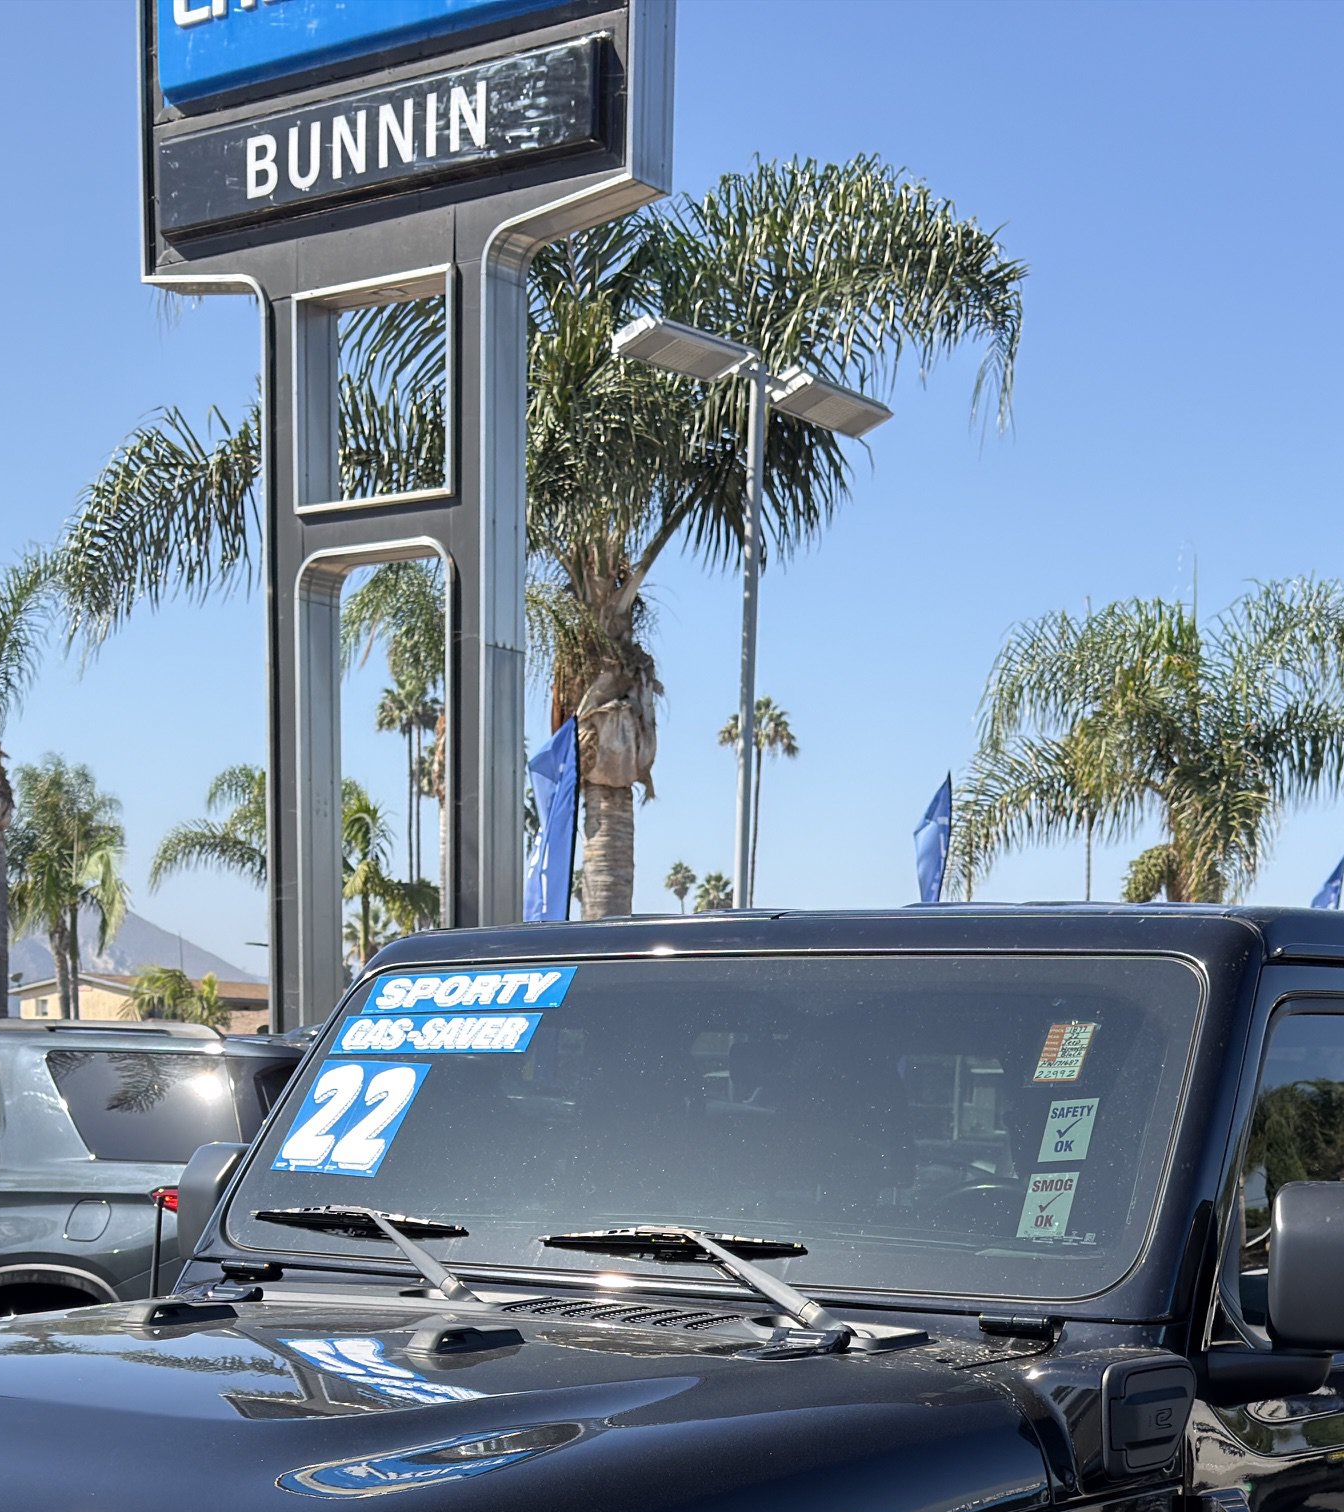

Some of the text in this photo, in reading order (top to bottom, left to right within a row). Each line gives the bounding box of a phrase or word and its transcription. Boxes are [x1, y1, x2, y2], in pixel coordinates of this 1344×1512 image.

[246, 80, 487, 199] BUNNIN
[375, 971, 562, 1009] SPORTY
[341, 1017, 530, 1050] GAS-SAVER
[1035, 1070, 1076, 1078] 22992
[281, 1064, 417, 1171] 22
[1050, 1104, 1094, 1120] SAFETY
[1054, 1139, 1075, 1153] OK
[1031, 1178, 1074, 1193] SMOG
[1034, 1214, 1054, 1228] OK
